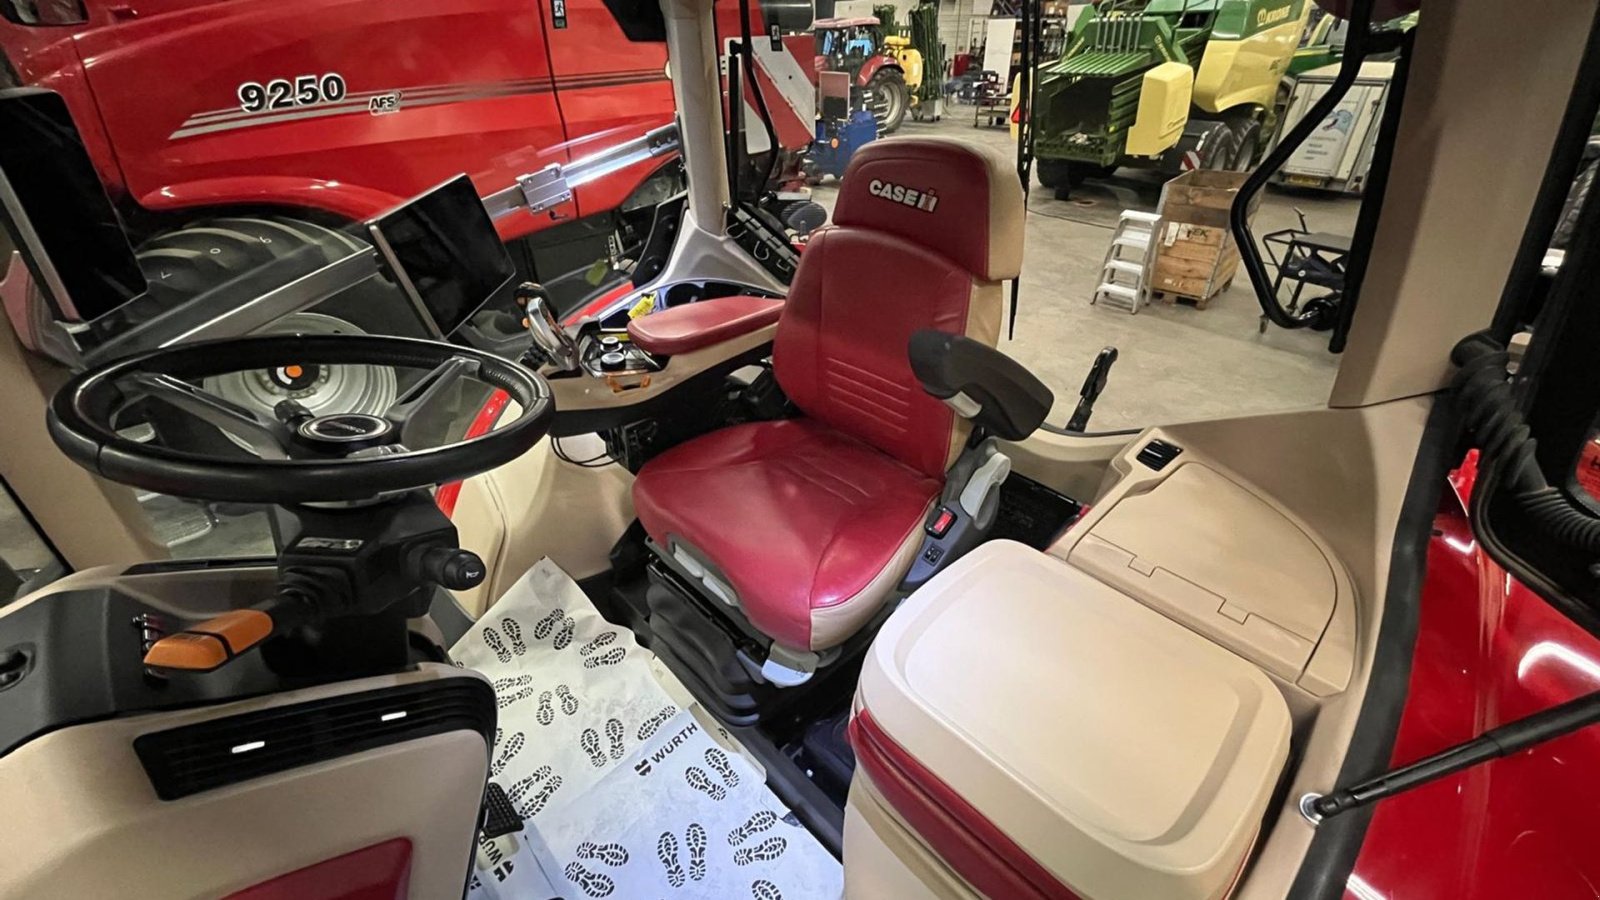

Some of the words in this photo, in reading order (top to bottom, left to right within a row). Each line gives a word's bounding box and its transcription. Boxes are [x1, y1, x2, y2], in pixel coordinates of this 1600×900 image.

[238, 73, 346, 113] 9250
[370, 94, 396, 109] AFS
[651, 722, 698, 763] WÜRTH
